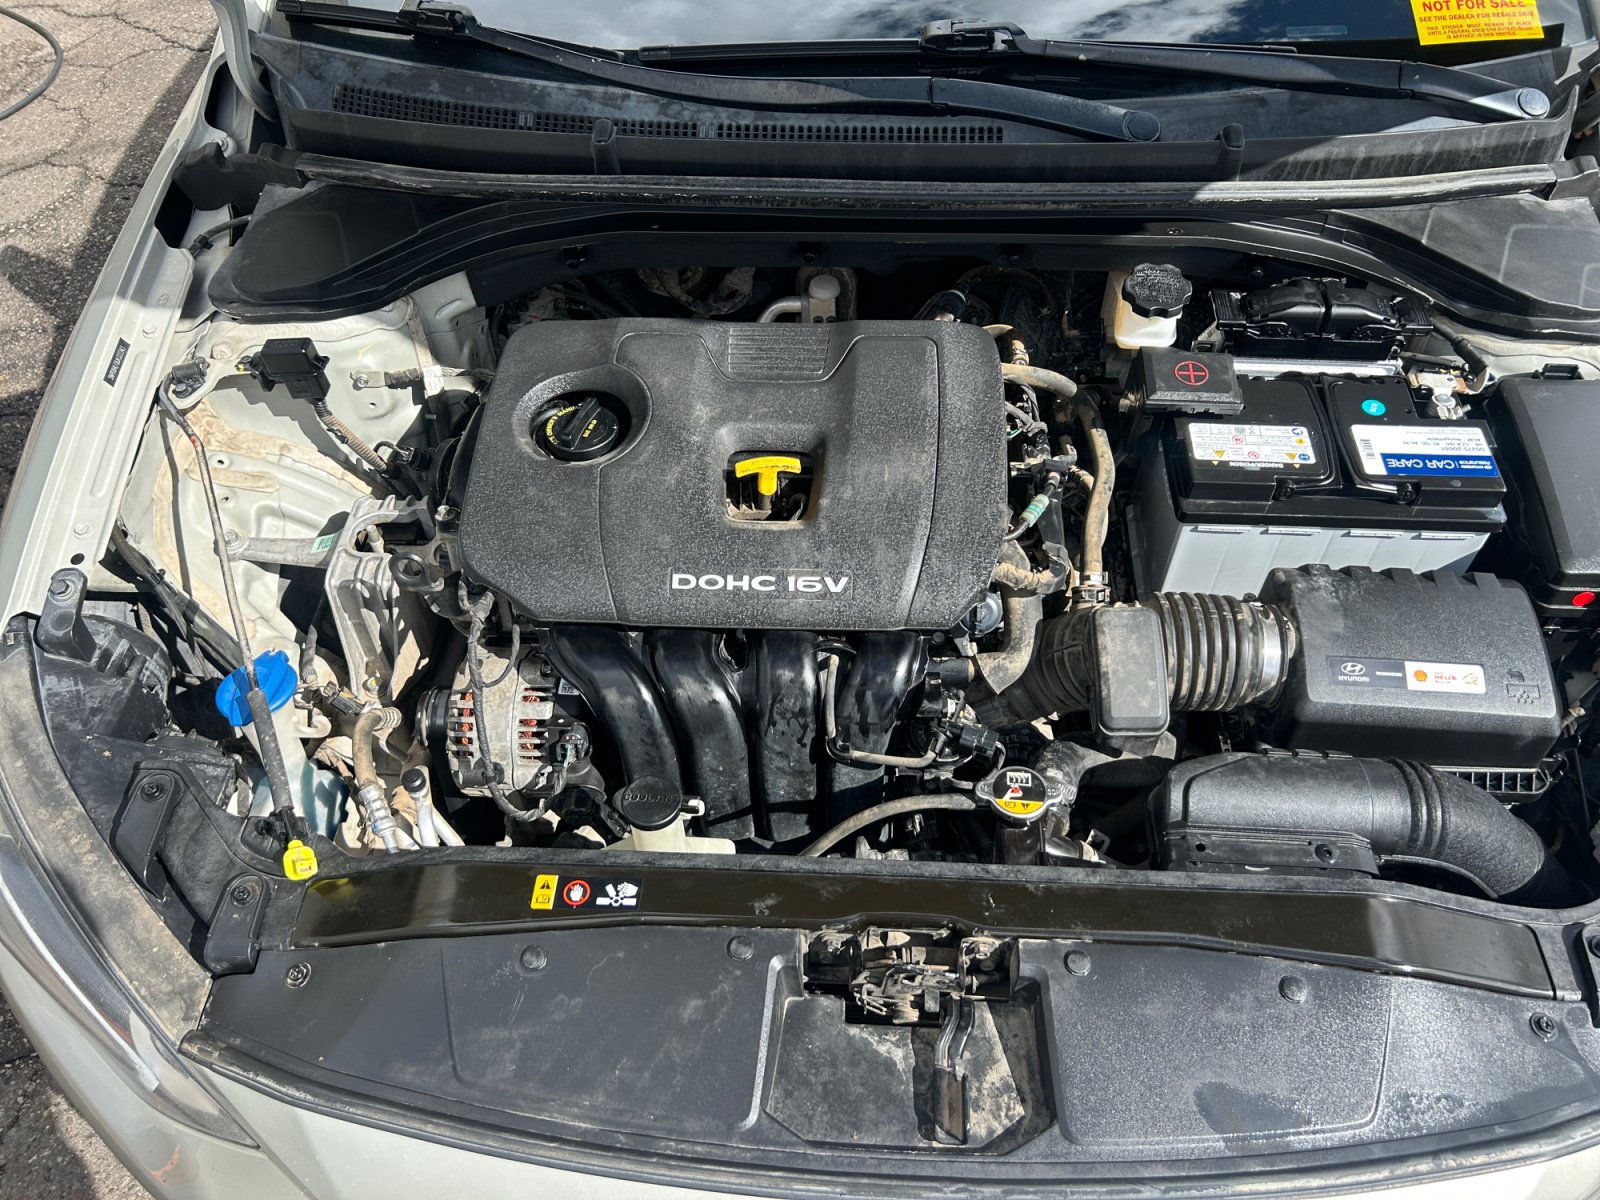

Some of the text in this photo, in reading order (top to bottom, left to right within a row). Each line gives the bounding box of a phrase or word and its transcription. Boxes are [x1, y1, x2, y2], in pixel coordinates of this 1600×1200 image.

[1423, 0, 1526, 12] NOT FOR SALE
[1387, 458, 1455, 469] CAR CARE
[671, 573, 849, 593] DOHC 16V
[1338, 675, 1370, 683] HYUNDAI
